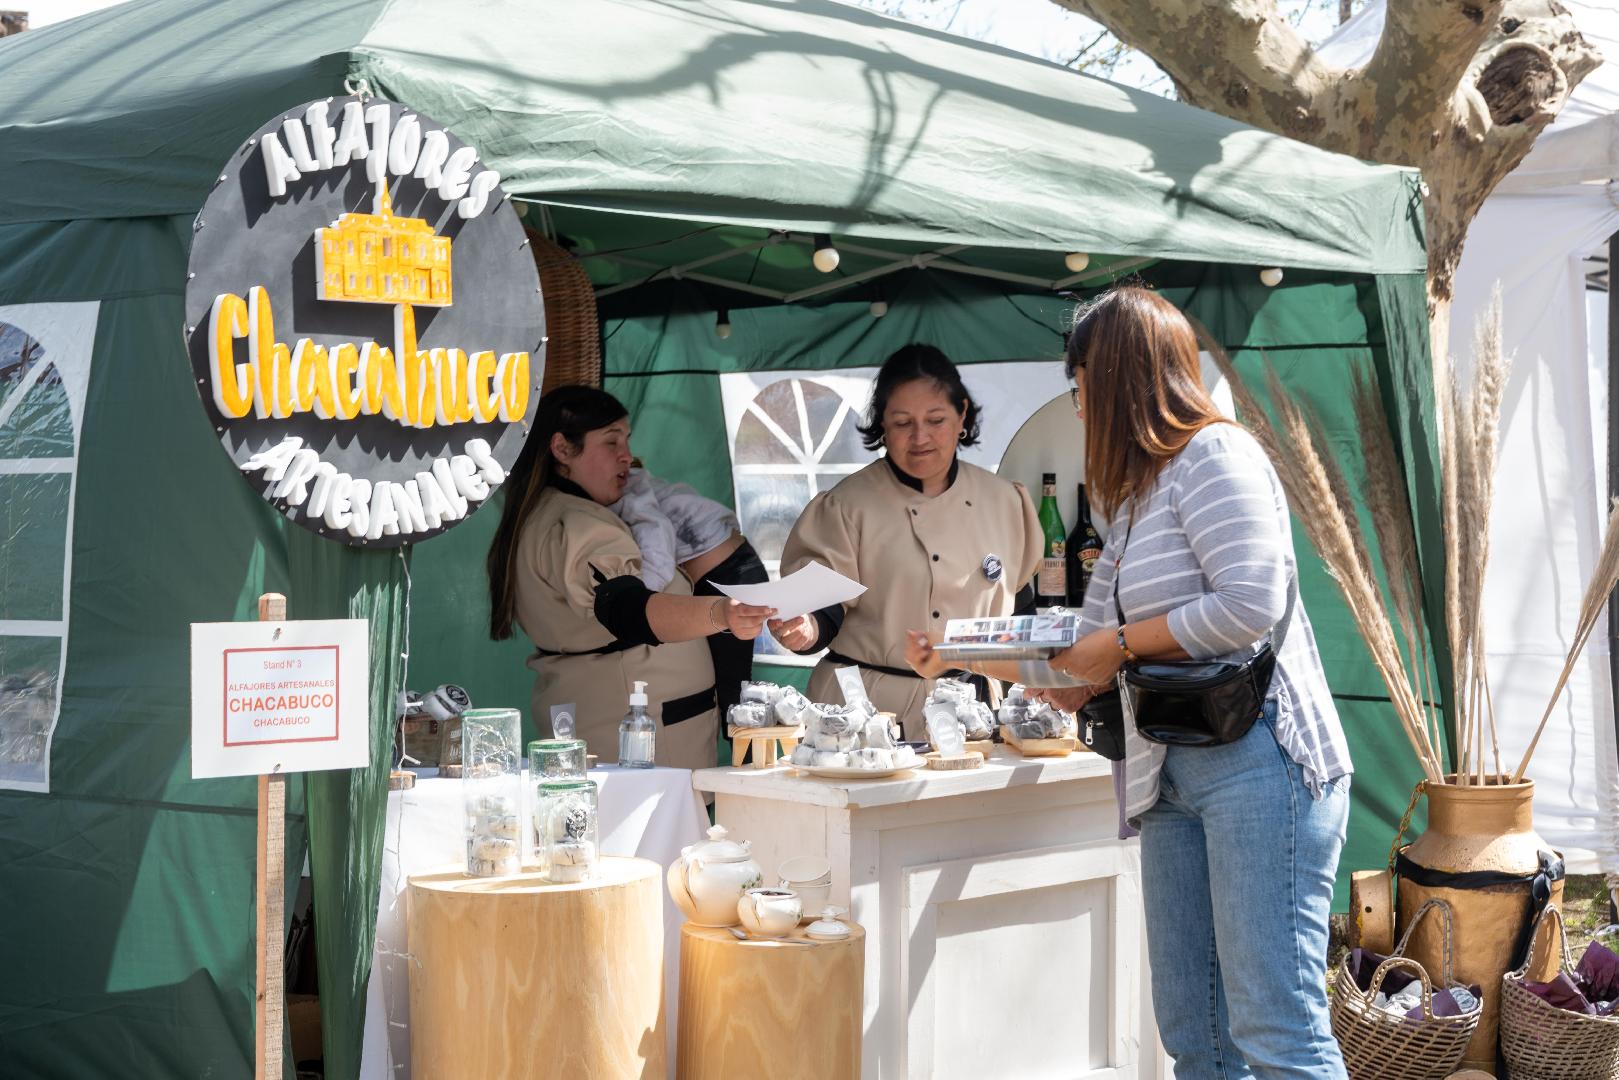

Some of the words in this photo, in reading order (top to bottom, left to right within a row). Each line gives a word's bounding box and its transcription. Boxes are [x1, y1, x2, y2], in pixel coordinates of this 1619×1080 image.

[261, 100, 500, 219] ALFAJORES
[208, 285, 530, 429] Chacabuco
[241, 436, 504, 540] ARTESANALES
[263, 660, 285, 670] Stand
[297, 659, 302, 669] 3
[228, 682, 276, 692] ALFAJORES
[277, 679, 335, 690] ARTESANALES
[229, 693, 334, 713] CHACABUCO
[253, 716, 311, 728] CHACABUCO
